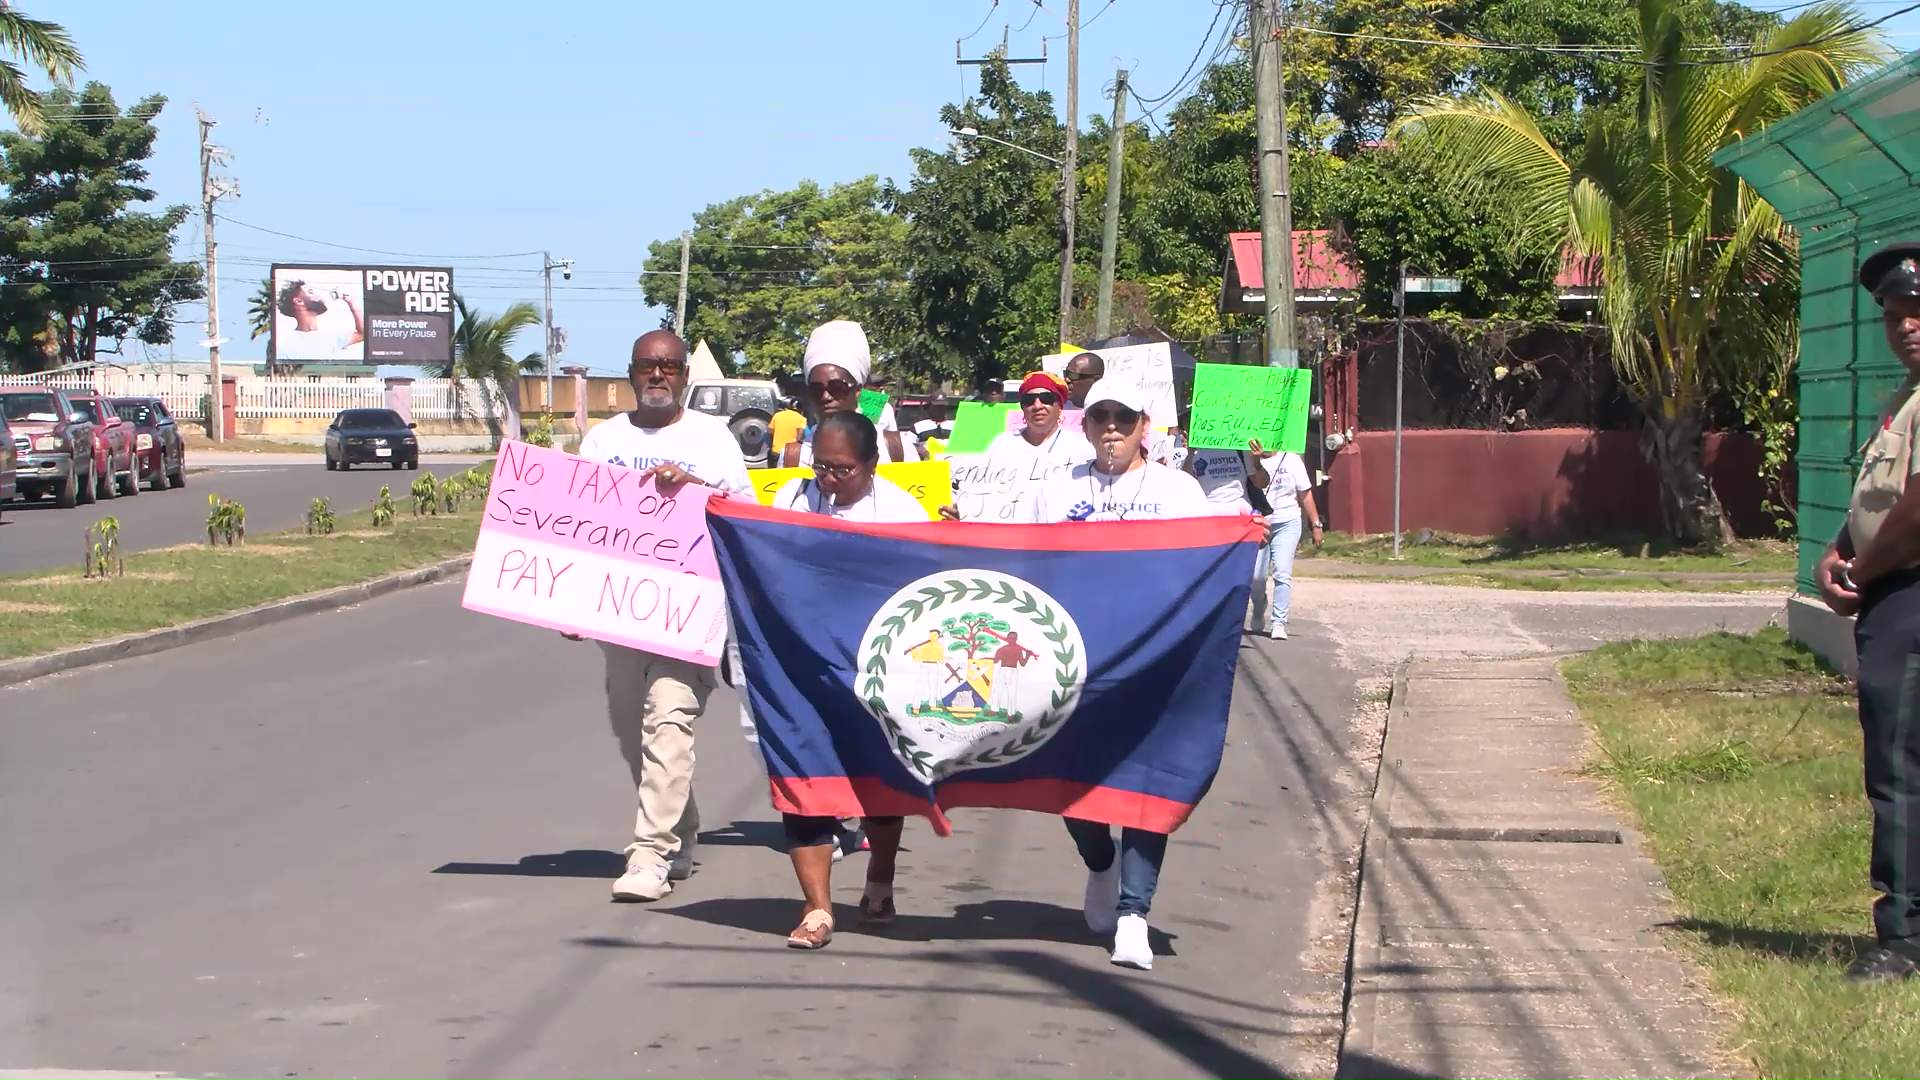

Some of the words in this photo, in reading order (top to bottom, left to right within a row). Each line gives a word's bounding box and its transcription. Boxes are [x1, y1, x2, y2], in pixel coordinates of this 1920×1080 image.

[366, 270, 450, 292] POWER
[405, 291, 450, 313] ADE
[372, 319, 397, 329] More
[398, 319, 428, 329] Power
[372, 329, 382, 338] In
[383, 329, 408, 340] Every
[410, 329, 437, 338] Pause
[1194, 391, 1232, 409] Court
[1193, 413, 1216, 432] has
[1220, 414, 1285, 432] RULED
[1228, 433, 1247, 447] The
[1209, 456, 1238, 465] JUSTICE
[499, 443, 545, 486] No
[567, 458, 630, 506] TAX
[637, 495, 677, 522] on
[945, 455, 1018, 494] ending
[999, 491, 1024, 519] of
[1099, 501, 1162, 516] JUSTICE
[489, 488, 705, 567] Severance!
[497, 549, 574, 599] PAY
